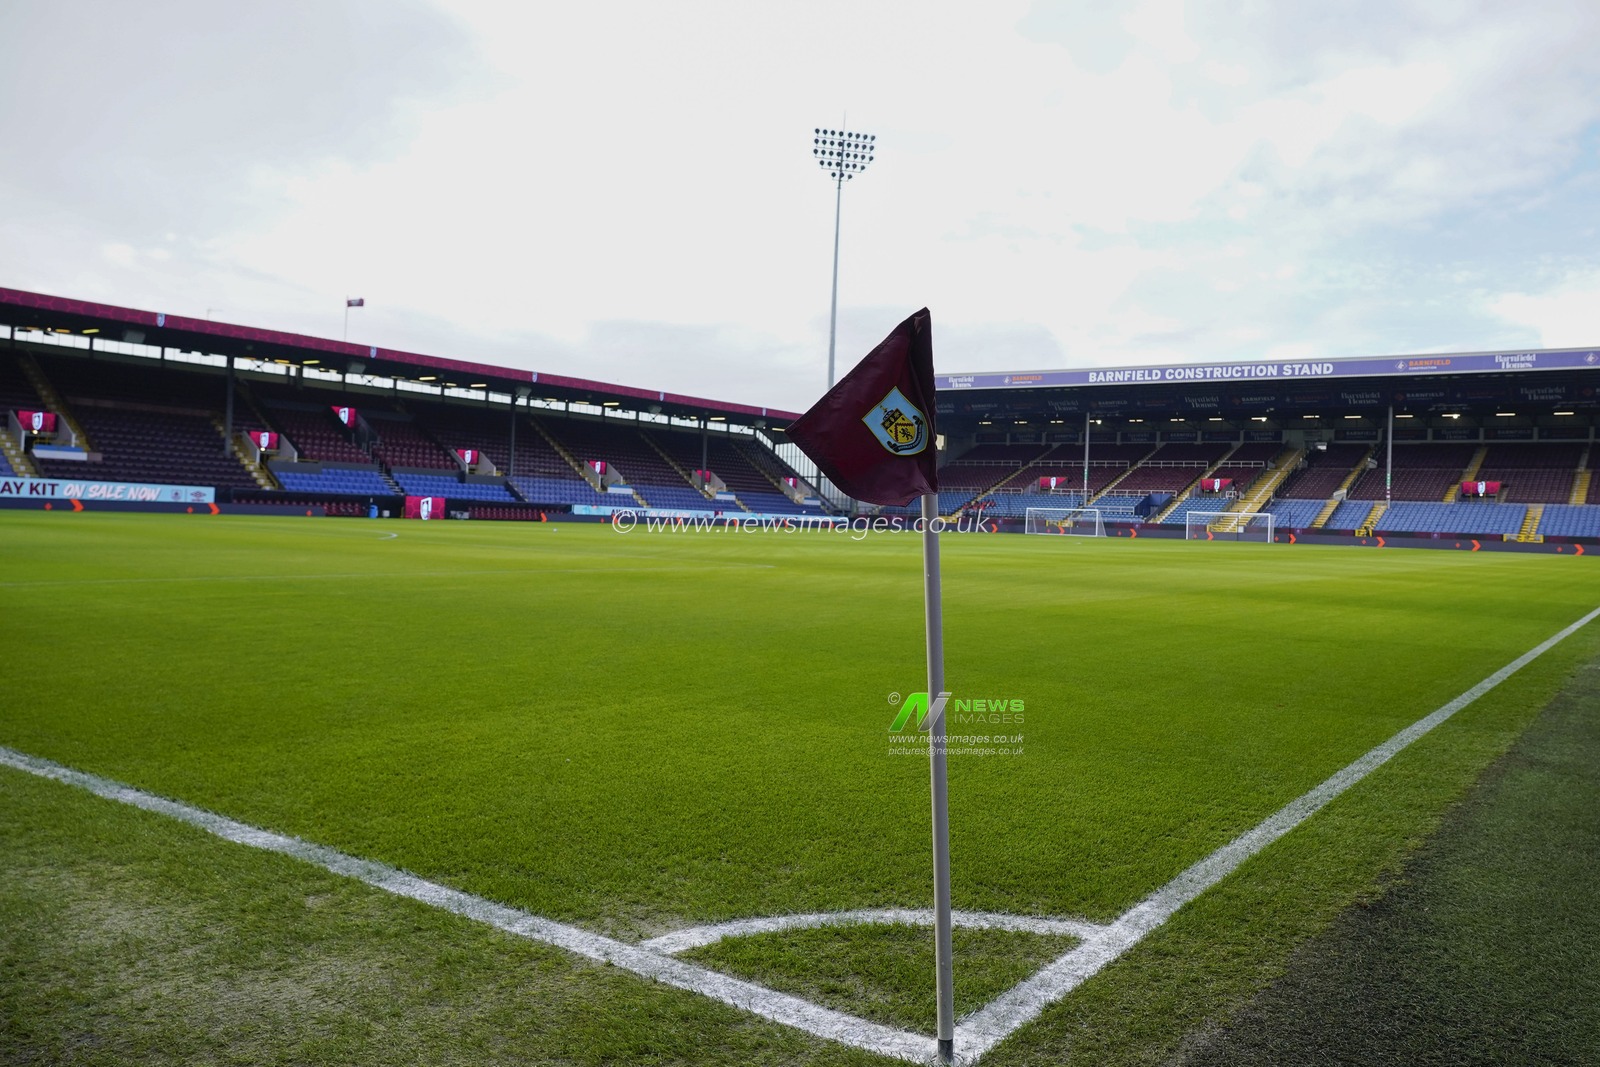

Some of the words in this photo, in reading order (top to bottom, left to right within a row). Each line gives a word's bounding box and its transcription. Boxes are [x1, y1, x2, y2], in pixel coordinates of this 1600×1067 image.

[1409, 359, 1451, 367] BARNFIELD
[1495, 354, 1536, 363] Barnfield
[1088, 369, 1161, 382] BARNFIELD
[1165, 365, 1278, 379] CONSTRUCTION
[1282, 363, 1334, 376] STAND
[29, 482, 59, 496] KIT
[63, 483, 86, 497] ON
[88, 483, 128, 499] SALE
[128, 487, 161, 501] NOW
